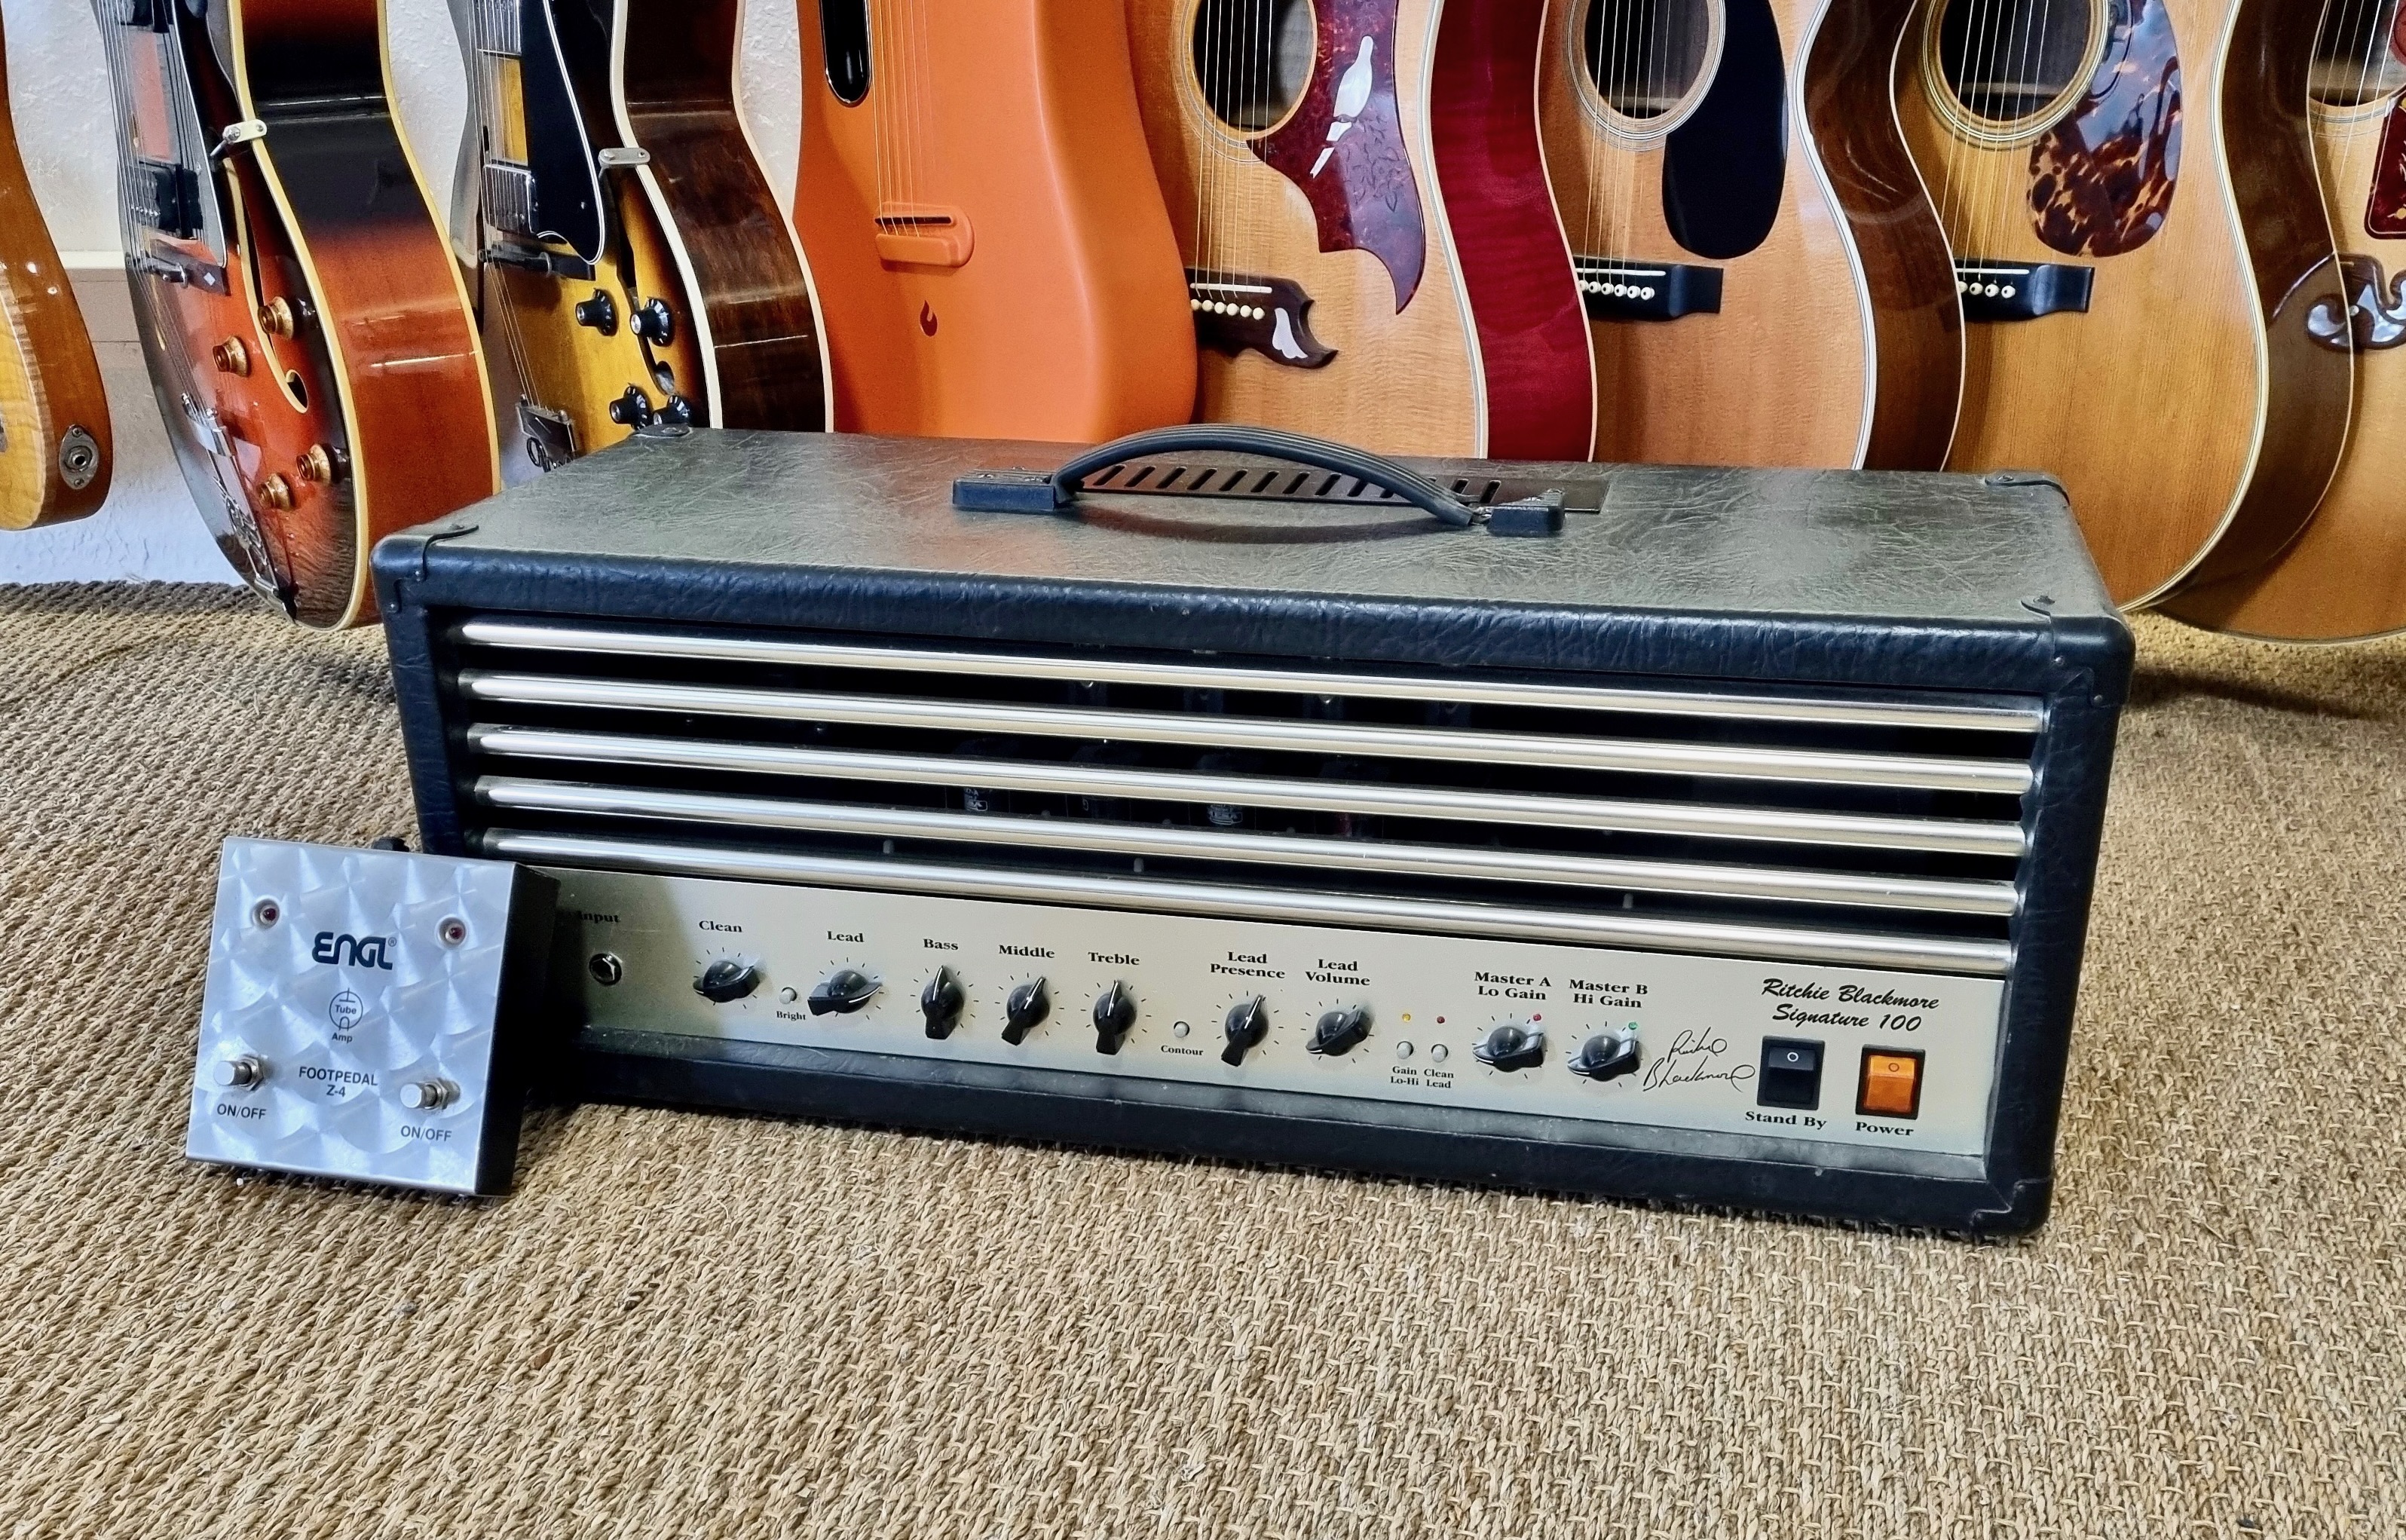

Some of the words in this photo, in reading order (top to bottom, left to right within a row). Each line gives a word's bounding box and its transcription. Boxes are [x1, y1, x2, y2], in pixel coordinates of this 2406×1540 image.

[699, 920, 742, 933] Clean
[827, 930, 865, 943] Lead
[923, 938, 959, 951] Bass
[998, 944, 1055, 959] Middle
[1088, 951, 1140, 966] Treble
[1227, 951, 1267, 964] Lead
[1210, 963, 1286, 979] Presence
[1318, 959, 1358, 972] Lead
[1305, 971, 1370, 986] Volume
[1474, 971, 1535, 987] Master
[1539, 977, 1552, 987] A
[1477, 985, 1499, 997] Lo
[1505, 987, 1547, 1000] Gain
[1569, 978, 1630, 994] Master
[1636, 984, 1648, 995] B
[1761, 978, 1831, 1001] Ritchie
[1838, 984, 1939, 1010] Blackmore
[1572, 993, 1594, 1005] Hi
[1599, 996, 1642, 1009] Gain
[335, 1004, 357, 1016] Tube
[776, 1010, 807, 1021] Bright
[1772, 1003, 1869, 1029] Signature
[1878, 1014, 1922, 1032] 100
[332, 1032, 353, 1044] Amp
[1161, 1044, 1204, 1056] Contour
[298, 1066, 378, 1086] FOOTPEDAL
[1391, 1065, 1417, 1076] Gain
[1424, 1067, 1454, 1079] Clean
[1390, 1076, 1419, 1086] Lo-Hi
[1426, 1079, 1452, 1089] Lead
[326, 1084, 346, 1098] Z-4
[217, 1103, 267, 1121] ON/OFF
[1745, 1110, 1797, 1126] Stand
[1804, 1116, 1828, 1130] By
[401, 1125, 452, 1143] ON/OFF
[1856, 1121, 1914, 1137] Power
